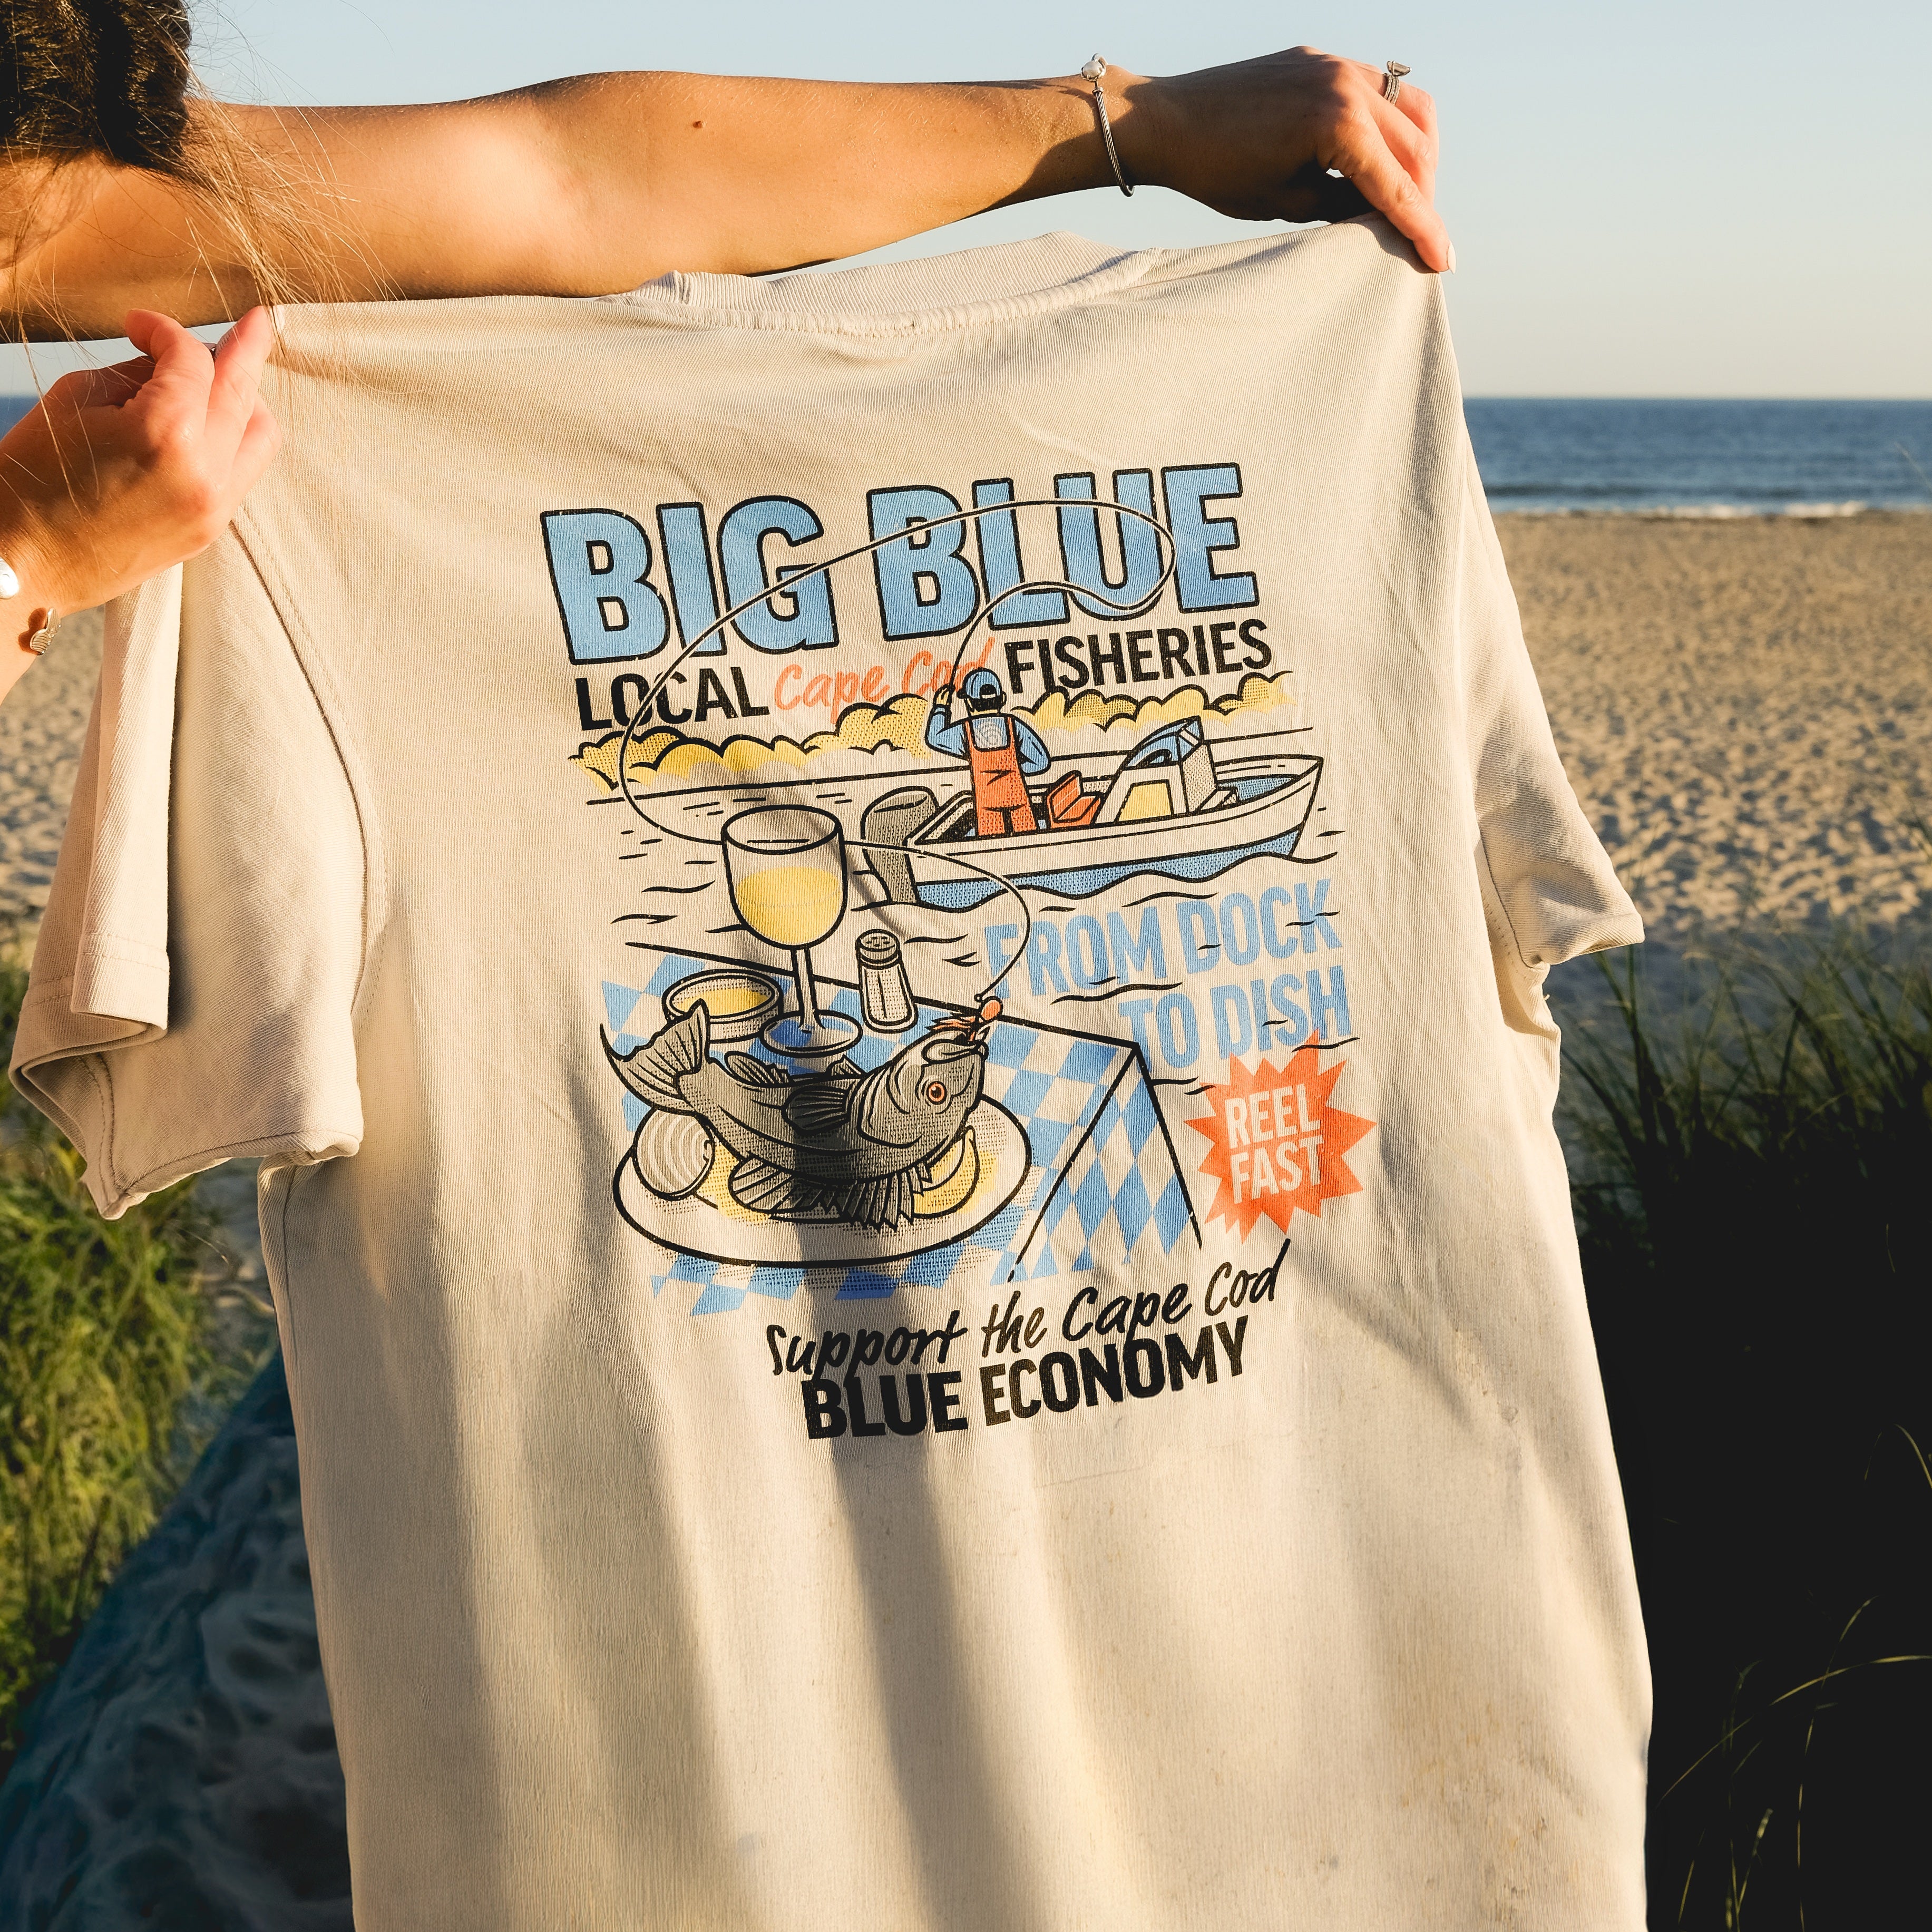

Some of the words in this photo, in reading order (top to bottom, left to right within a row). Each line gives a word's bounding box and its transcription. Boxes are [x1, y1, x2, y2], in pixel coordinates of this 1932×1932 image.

[540, 496, 840, 665] BIG
[867, 463, 1259, 640] BLUE
[575, 667, 769, 730] LOCAL
[774, 664, 890, 723] Cape
[903, 637, 995, 695] Cod
[1005, 619, 1272, 693] FISHERIES
[984, 906, 1167, 999] FROM
[1176, 879, 1342, 974] DOCK
[1120, 993, 1198, 1074] TO
[1210, 965, 1351, 1058] DISH
[1224, 1084, 1321, 1145] REEL
[1230, 1135, 1324, 1205] FAST
[766, 1310, 967, 1380] Support
[981, 1291, 1047, 1358] the
[1062, 1280, 1192, 1350] Cape
[1204, 1238, 1291, 1316] Cod
[801, 1371, 969, 1439] BLUE
[980, 1315, 1249, 1427] ECONOMY
